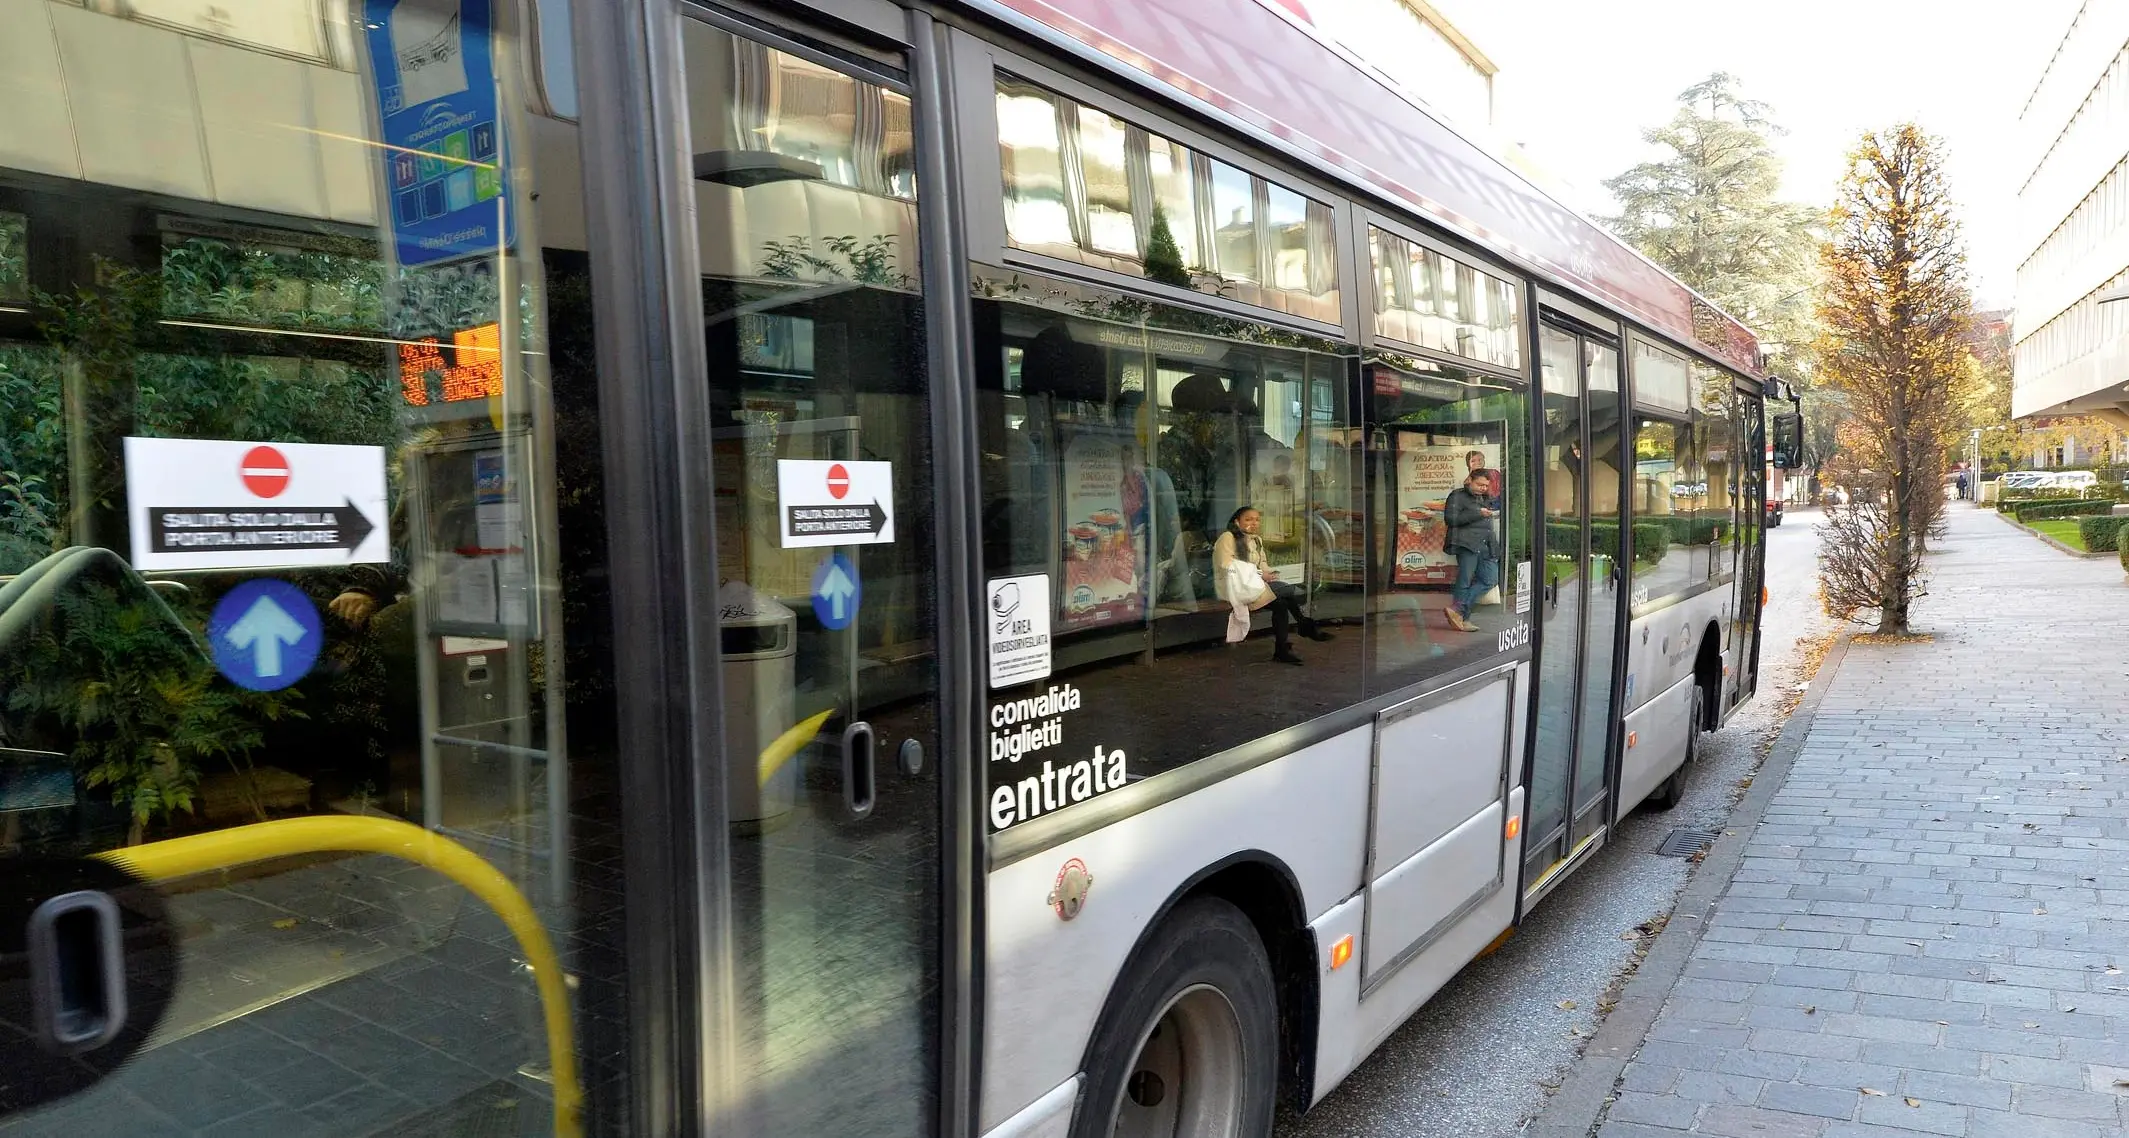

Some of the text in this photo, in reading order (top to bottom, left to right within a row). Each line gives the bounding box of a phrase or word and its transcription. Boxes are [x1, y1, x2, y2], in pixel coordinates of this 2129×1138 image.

[1012, 619, 1032, 637] AREA
[1498, 619, 1529, 653] uscita
[991, 683, 1081, 728] convalida
[991, 717, 1062, 763] biglietti
[990, 745, 1127, 830] entrata
